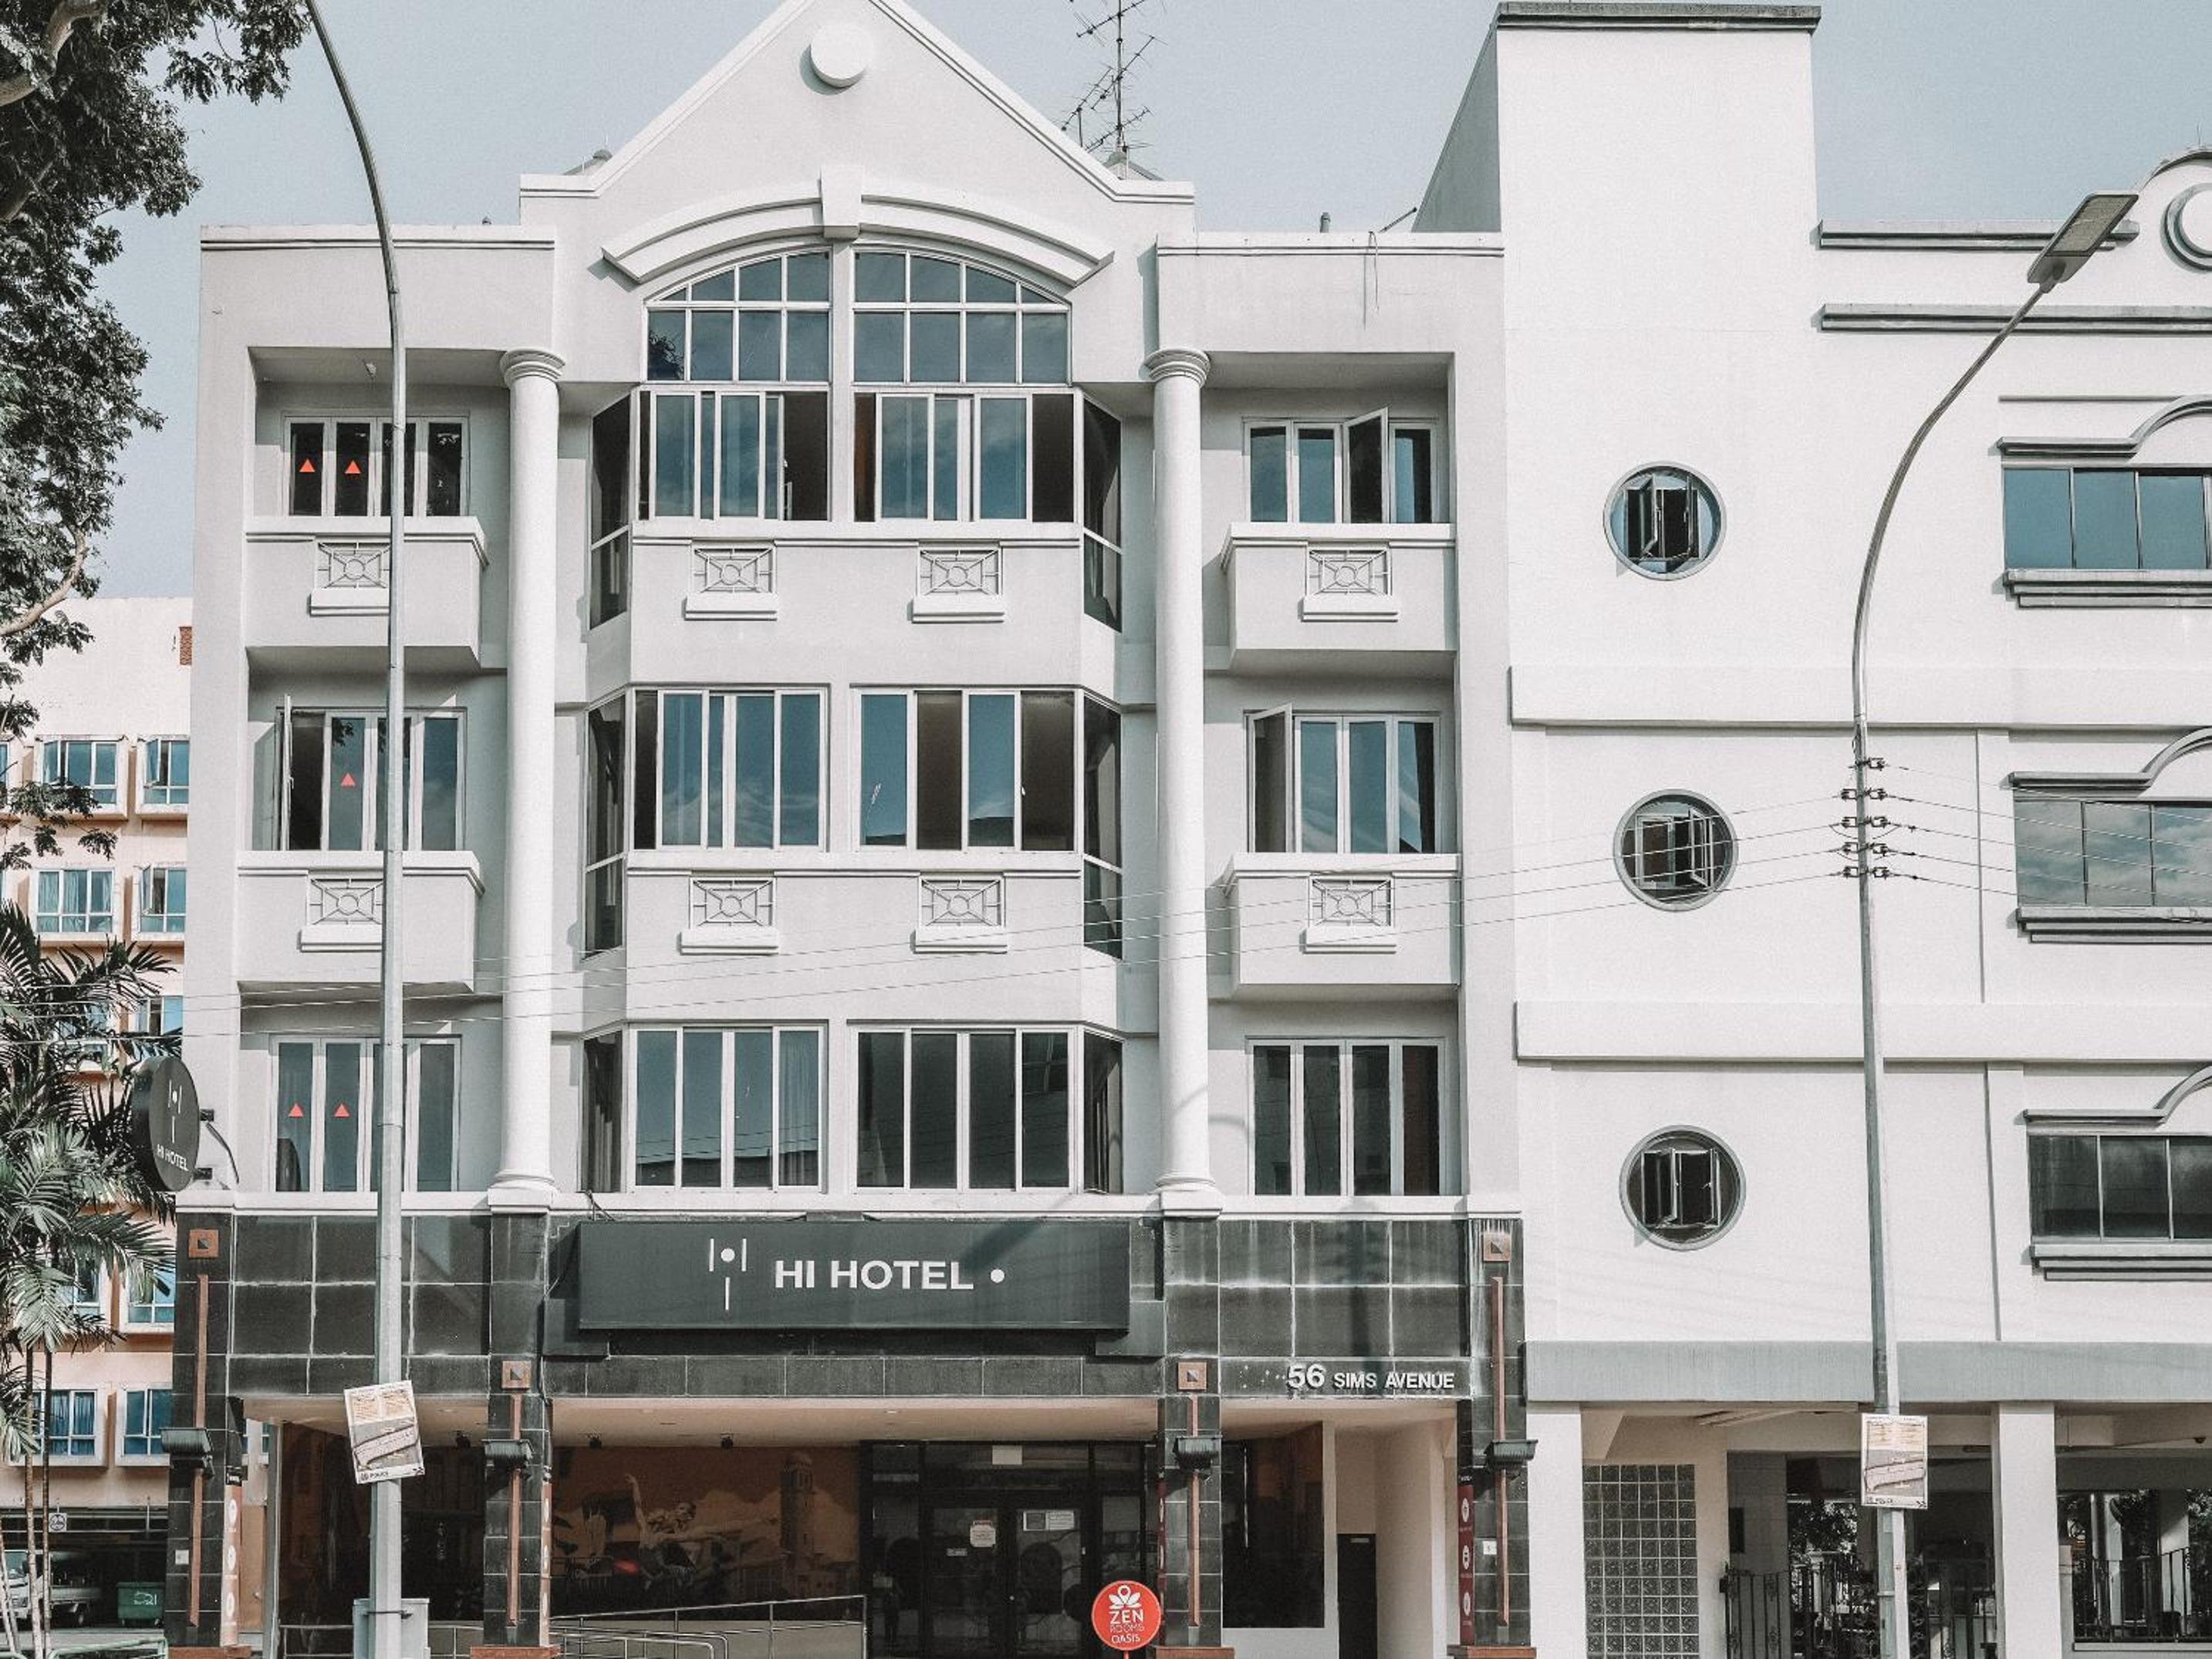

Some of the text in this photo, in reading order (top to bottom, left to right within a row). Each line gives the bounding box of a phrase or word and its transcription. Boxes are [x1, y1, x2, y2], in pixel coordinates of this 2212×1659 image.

[157, 1144, 189, 1172] HI HOTEL
[775, 1260, 974, 1290] HI HOTEL
[1287, 1363, 1455, 1389] 56 SIMS AVENUE
[1109, 1609, 1143, 1624] ZEN
[1111, 1634, 1141, 1644] OASIS
